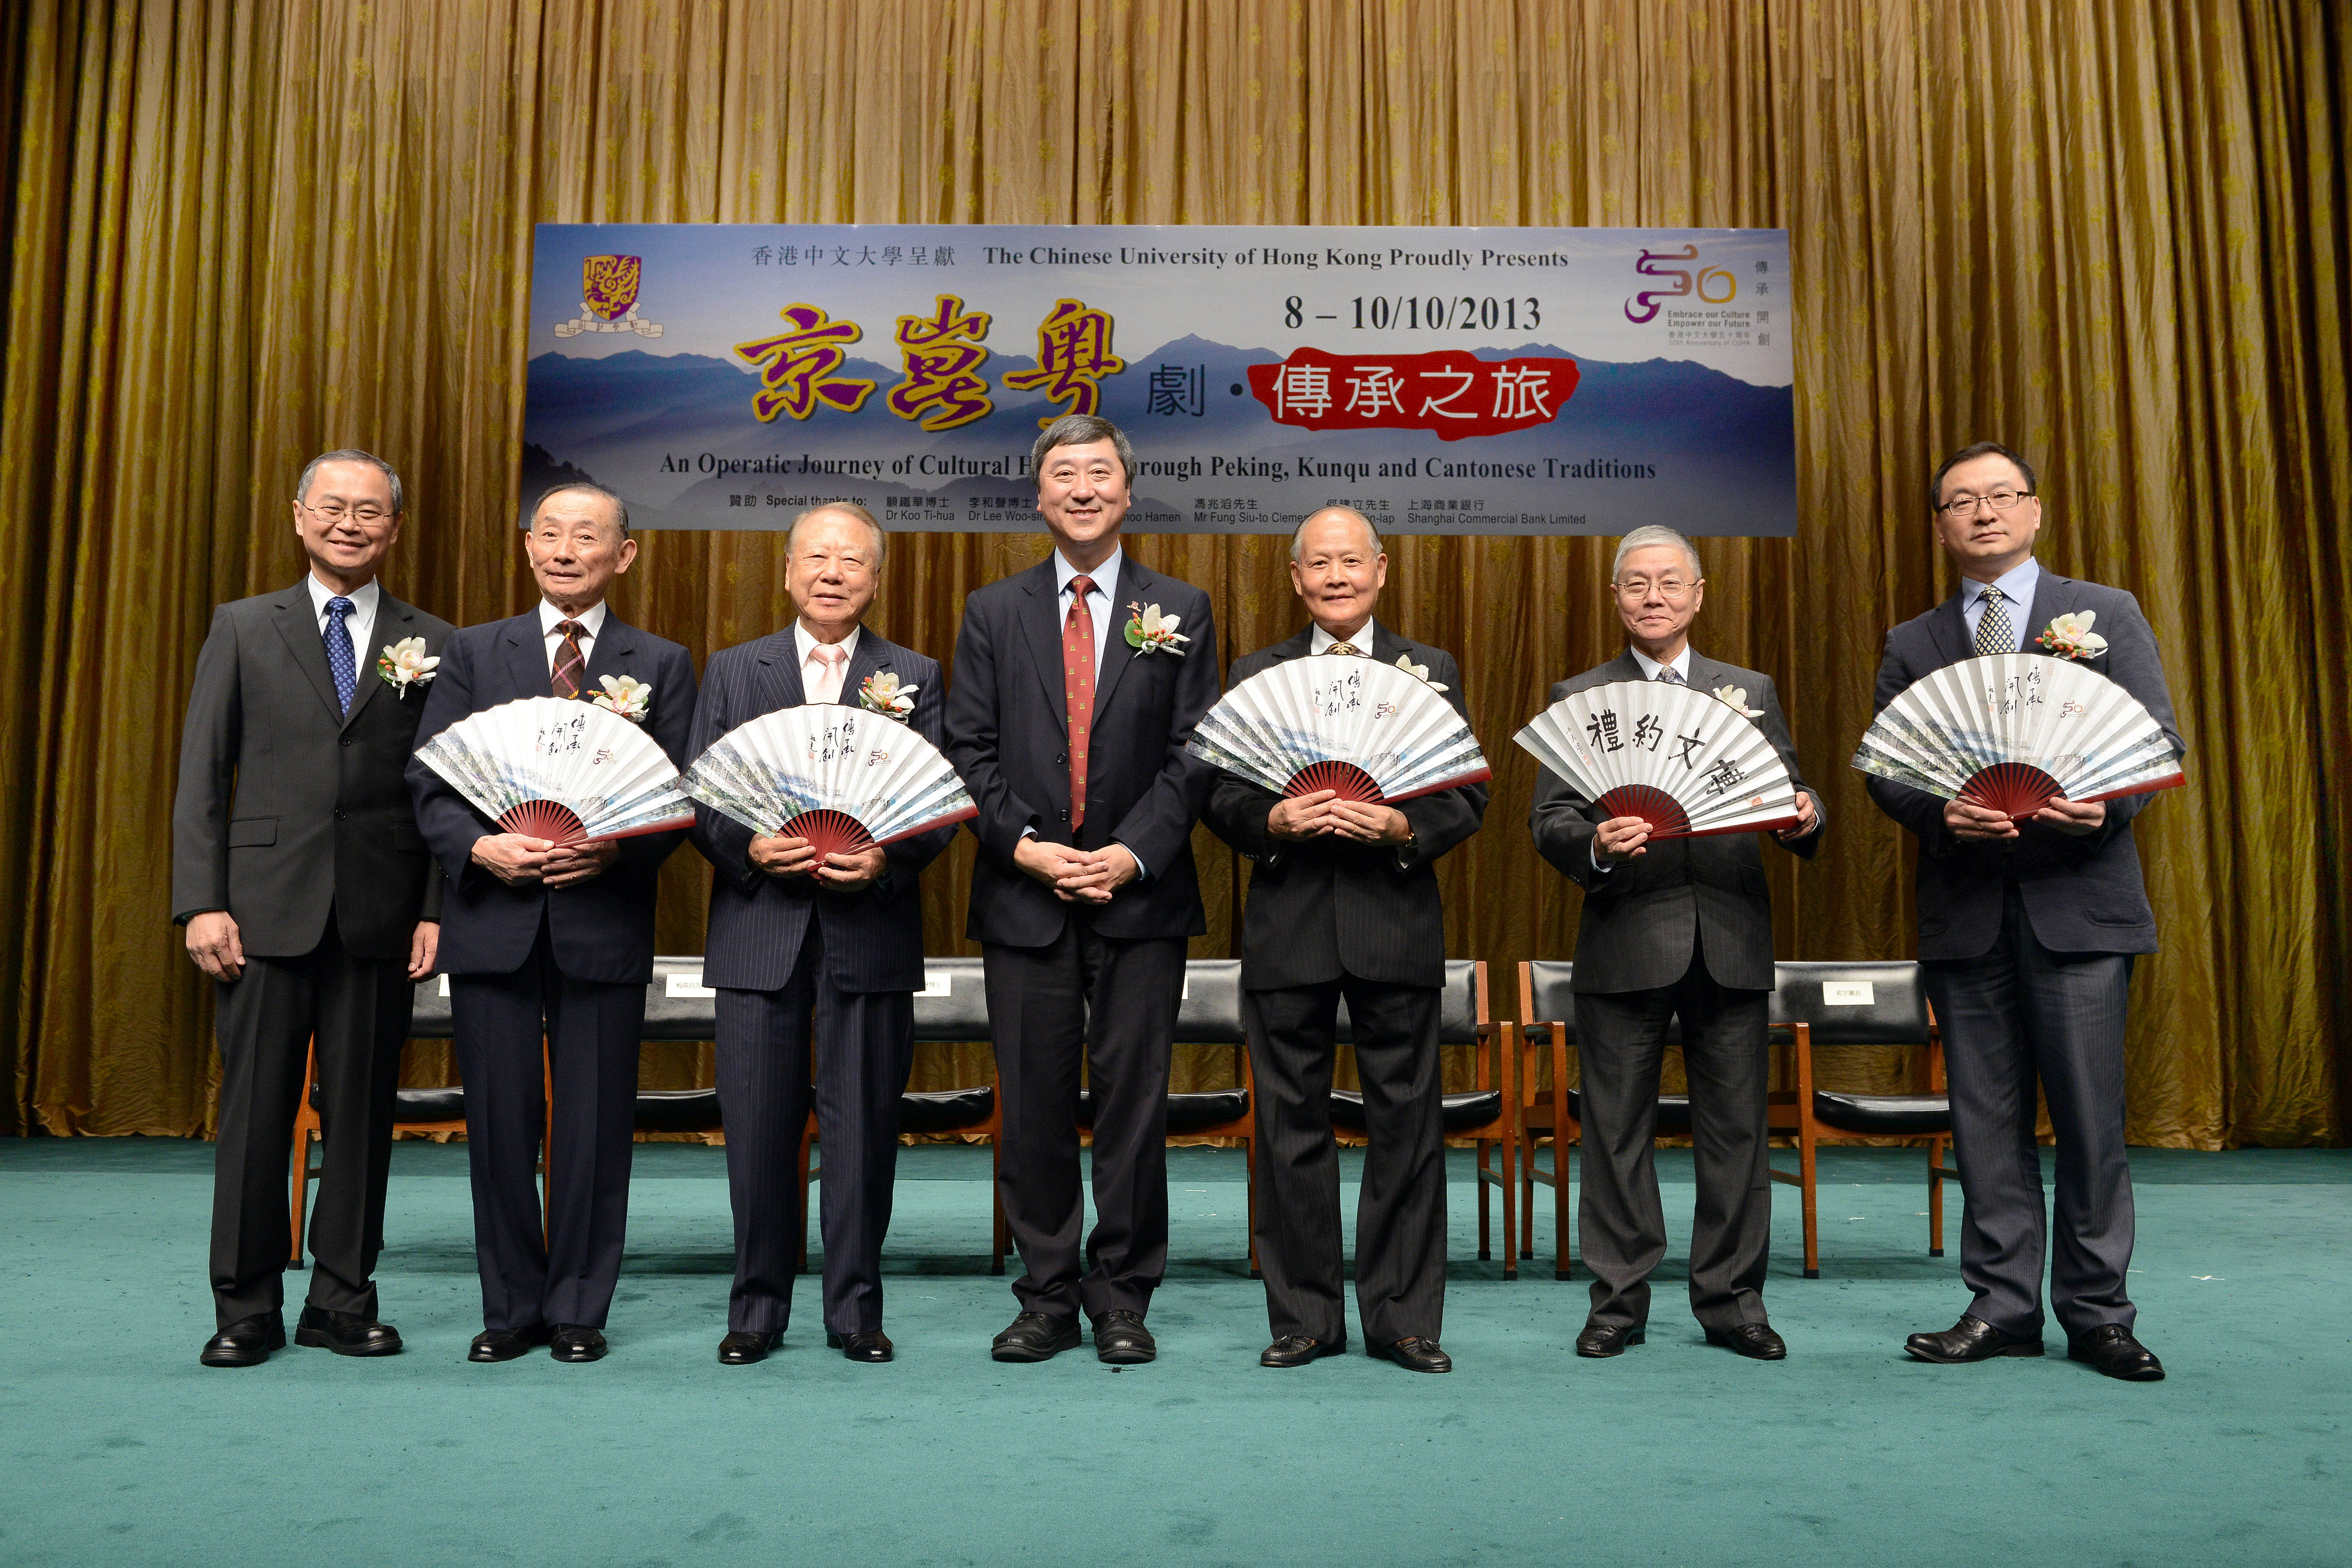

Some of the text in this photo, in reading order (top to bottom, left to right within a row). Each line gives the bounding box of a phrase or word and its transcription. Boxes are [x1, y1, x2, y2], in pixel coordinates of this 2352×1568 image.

[752, 245, 955, 266] 香港中文大學呈獻
[983, 247, 1568, 271] The Chinese University of Hong Kong Proudly Presents
[1285, 296, 1303, 329] 8
[1353, 296, 1540, 330] 10/10/2013
[1668, 310, 1703, 318] Embrace
[1721, 311, 1750, 319] Culture
[1668, 319, 1705, 328] Empower
[1724, 320, 1750, 328] Future
[660, 454, 689, 472] An
[698, 453, 791, 479] Operatic
[798, 454, 883, 480] Journey
[892, 455, 914, 474] of
[919, 455, 1011, 476] Cultural
[1211, 456, 1289, 482] Peking,
[1298, 457, 1369, 483] Kunqu
[1378, 458, 1417, 477] and
[1425, 458, 1536, 478] Cantonese
[1543, 458, 1656, 478] Traditions
[766, 494, 807, 508] Special
[852, 496, 867, 506] to:
[1408, 499, 1484, 511] 上海商業銀行
[886, 510, 954, 521] Dr Koo Ti-hua
[968, 510, 980, 521] Dr
[983, 510, 1002, 521] Lee
[1145, 512, 1181, 522] Hamen
[1194, 512, 1208, 522] Mr
[1210, 512, 1235, 525] Fung
[1239, 512, 1268, 523] Siu-to
[1407, 513, 1586, 526] Shanghai Commercial Bank Limited
